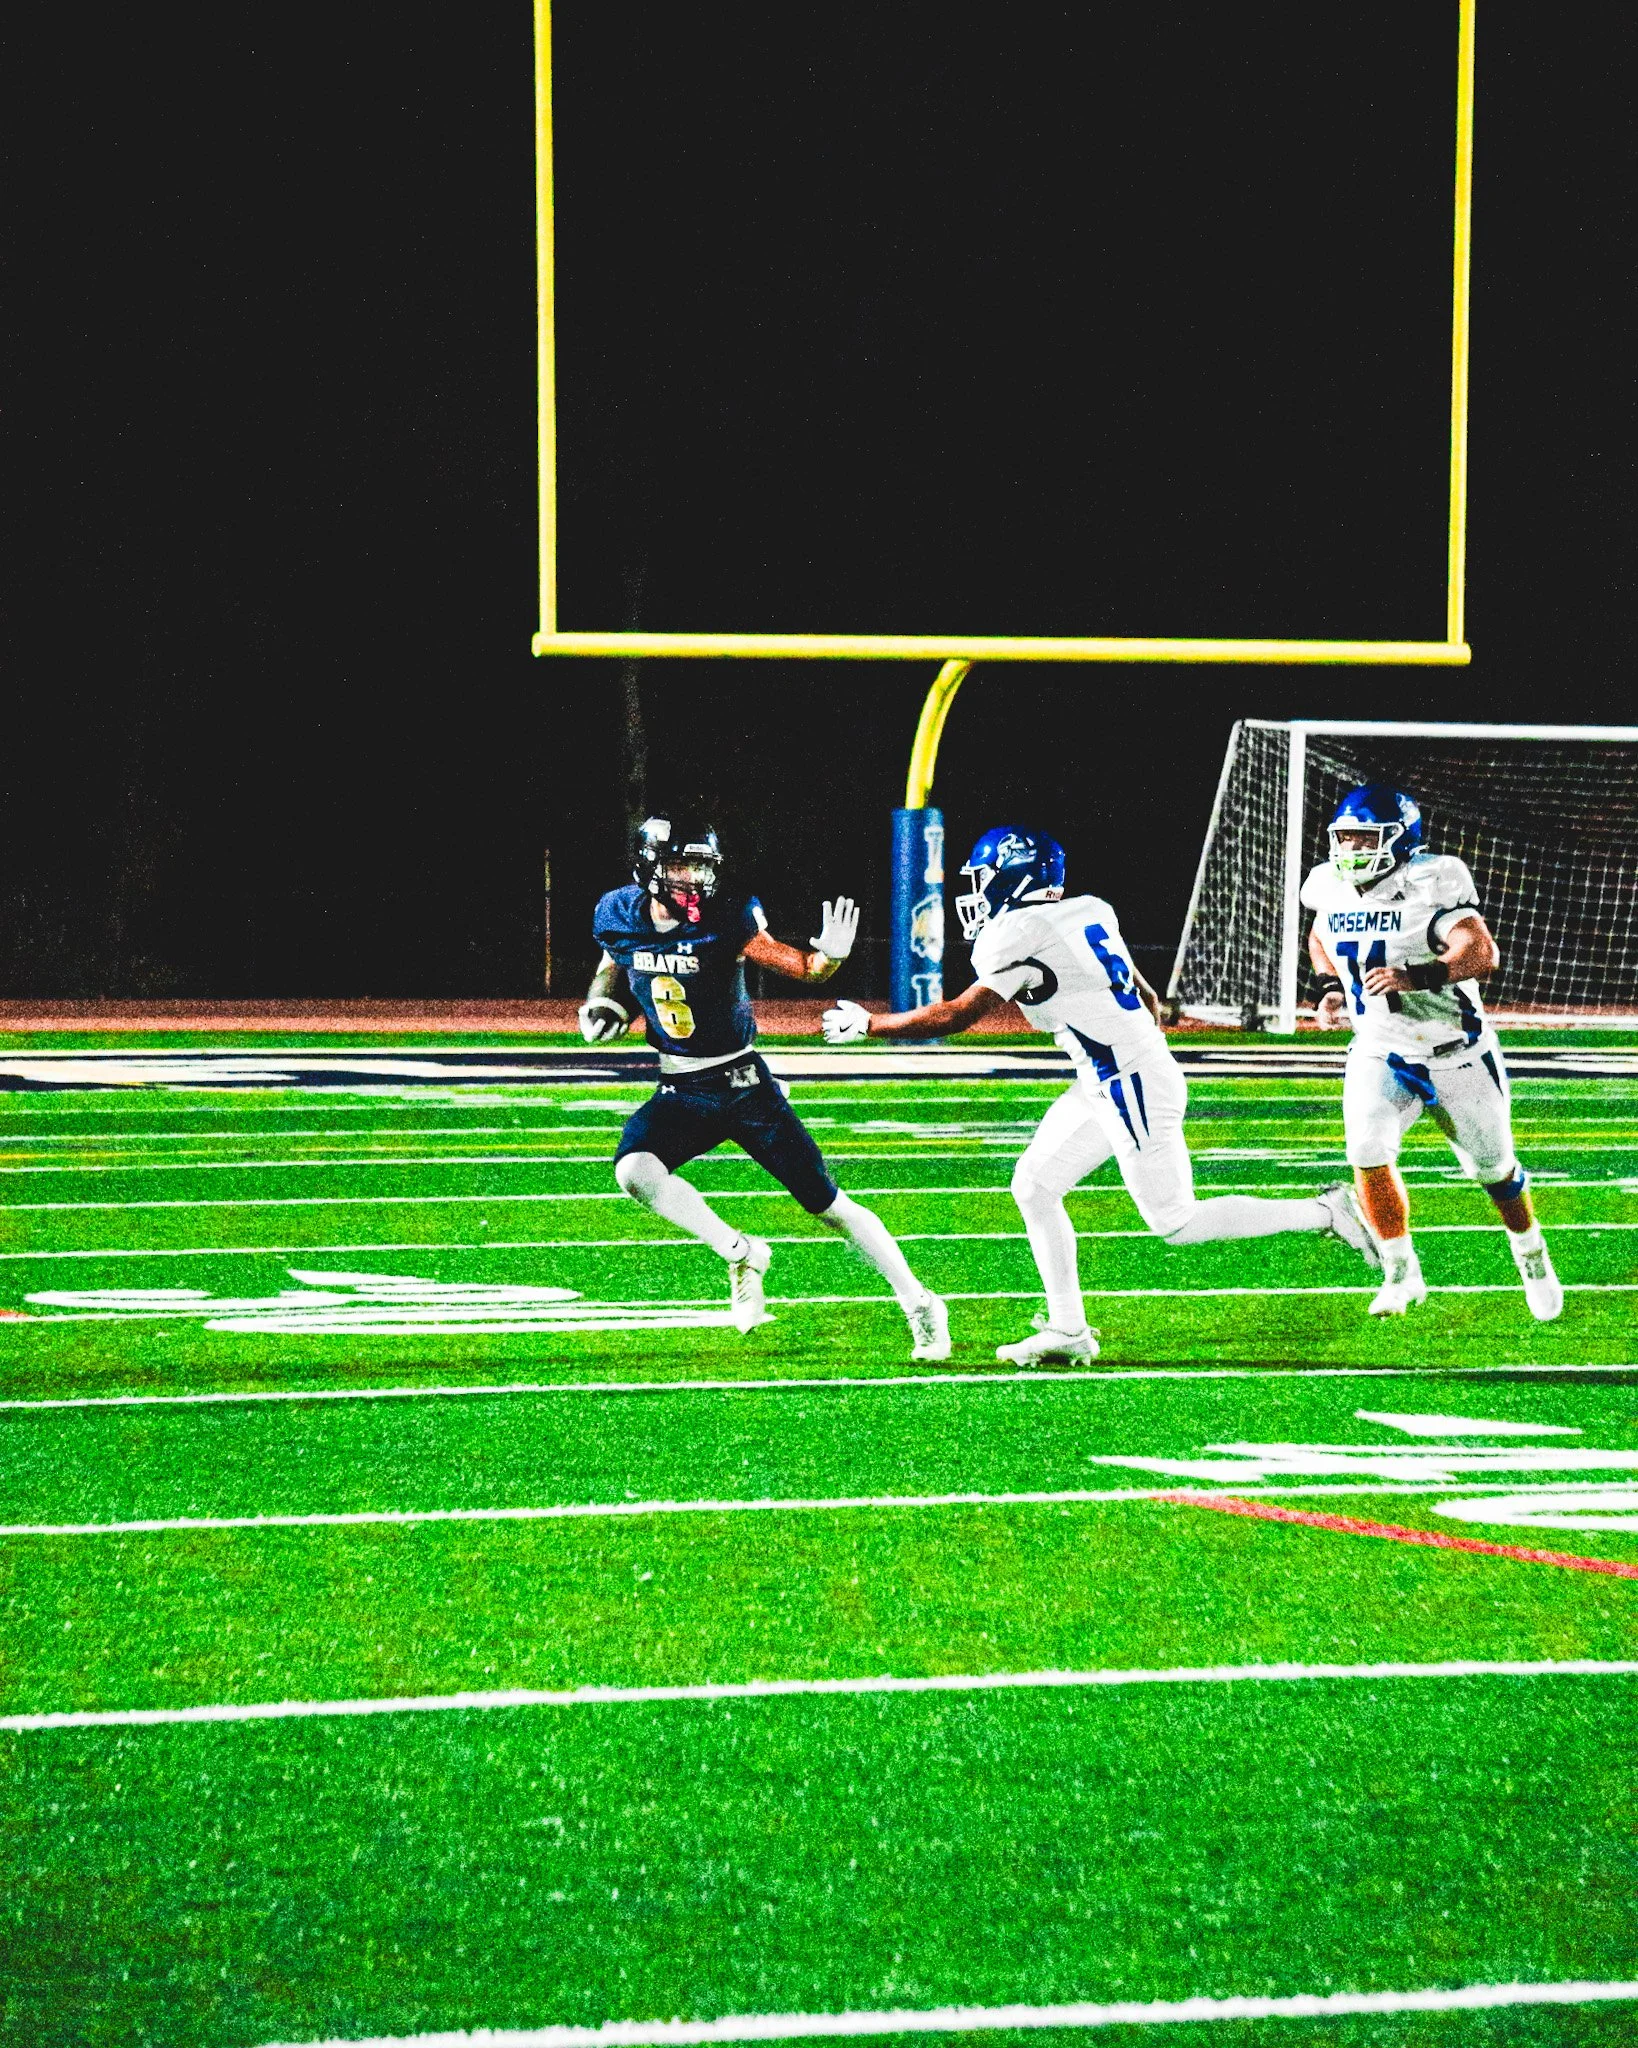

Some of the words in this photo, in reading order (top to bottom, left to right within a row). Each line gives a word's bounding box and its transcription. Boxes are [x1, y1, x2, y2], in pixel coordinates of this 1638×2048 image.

[1327, 911, 1402, 933] NORSEMEN
[632, 951, 700, 974] BRAVES
[650, 976, 697, 1039] 6
